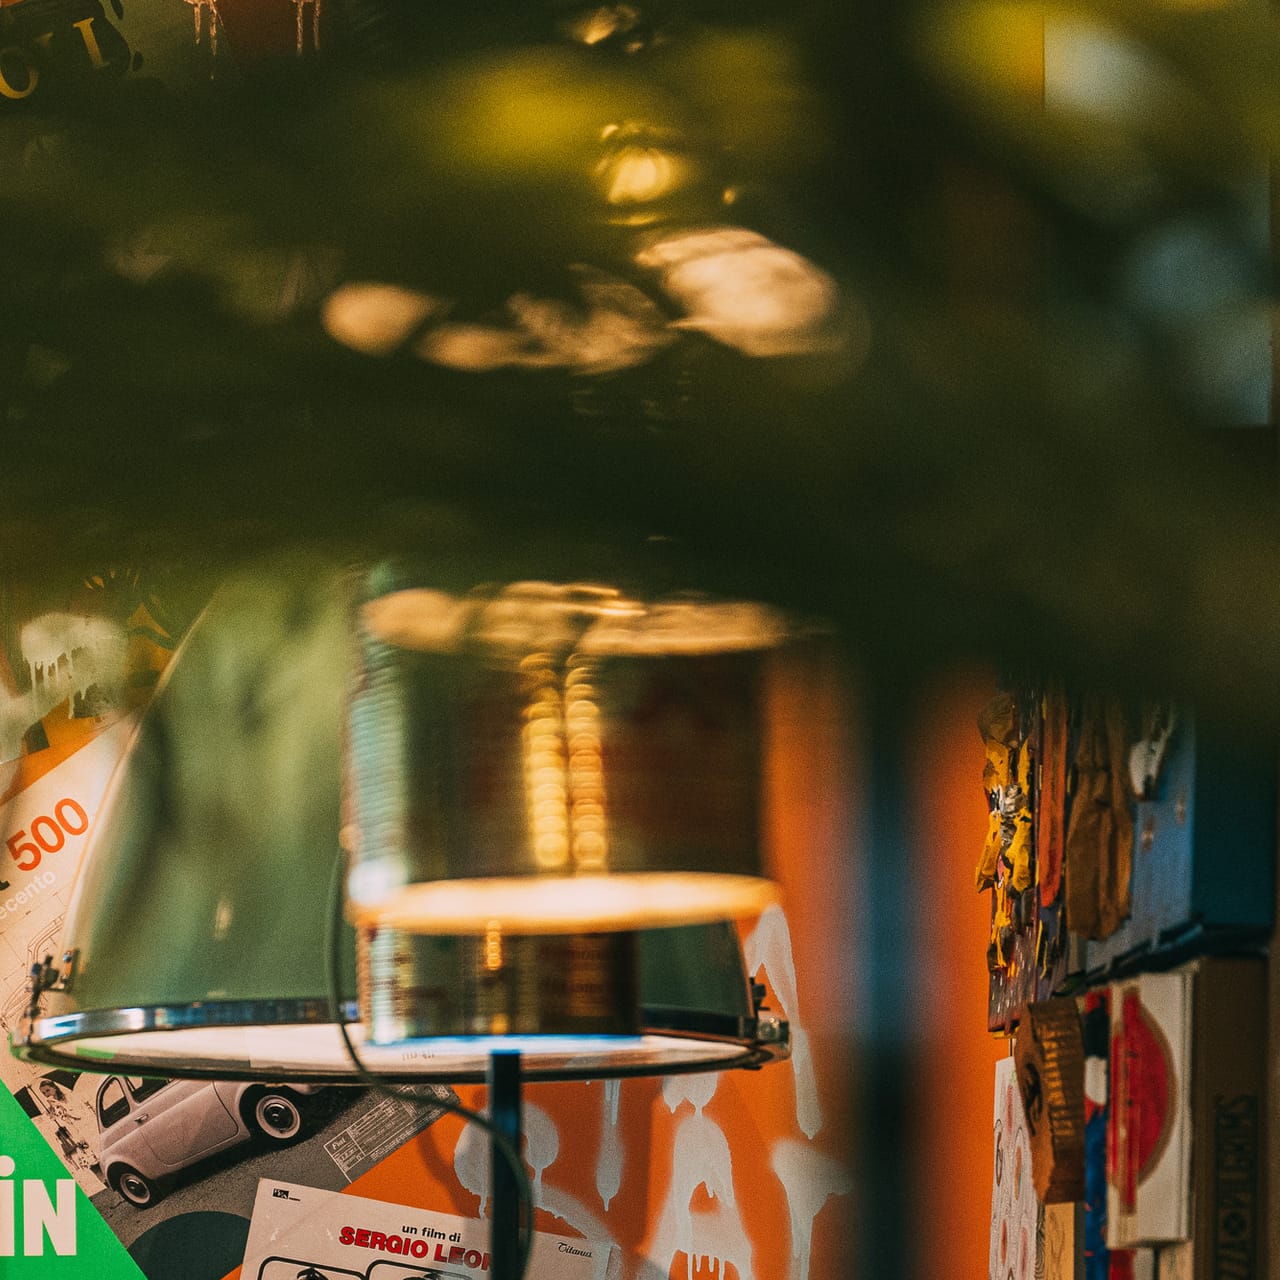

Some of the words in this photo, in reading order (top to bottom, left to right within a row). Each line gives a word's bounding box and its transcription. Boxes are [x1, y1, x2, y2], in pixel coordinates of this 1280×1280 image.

[5, 798, 89, 871] 500
[339, 1226, 429, 1259] SERGIO
[434, 1243, 491, 1271] LEO
[401, 1224, 418, 1236] un
[421, 1226, 446, 1241] film
[448, 1230, 461, 1243] di
